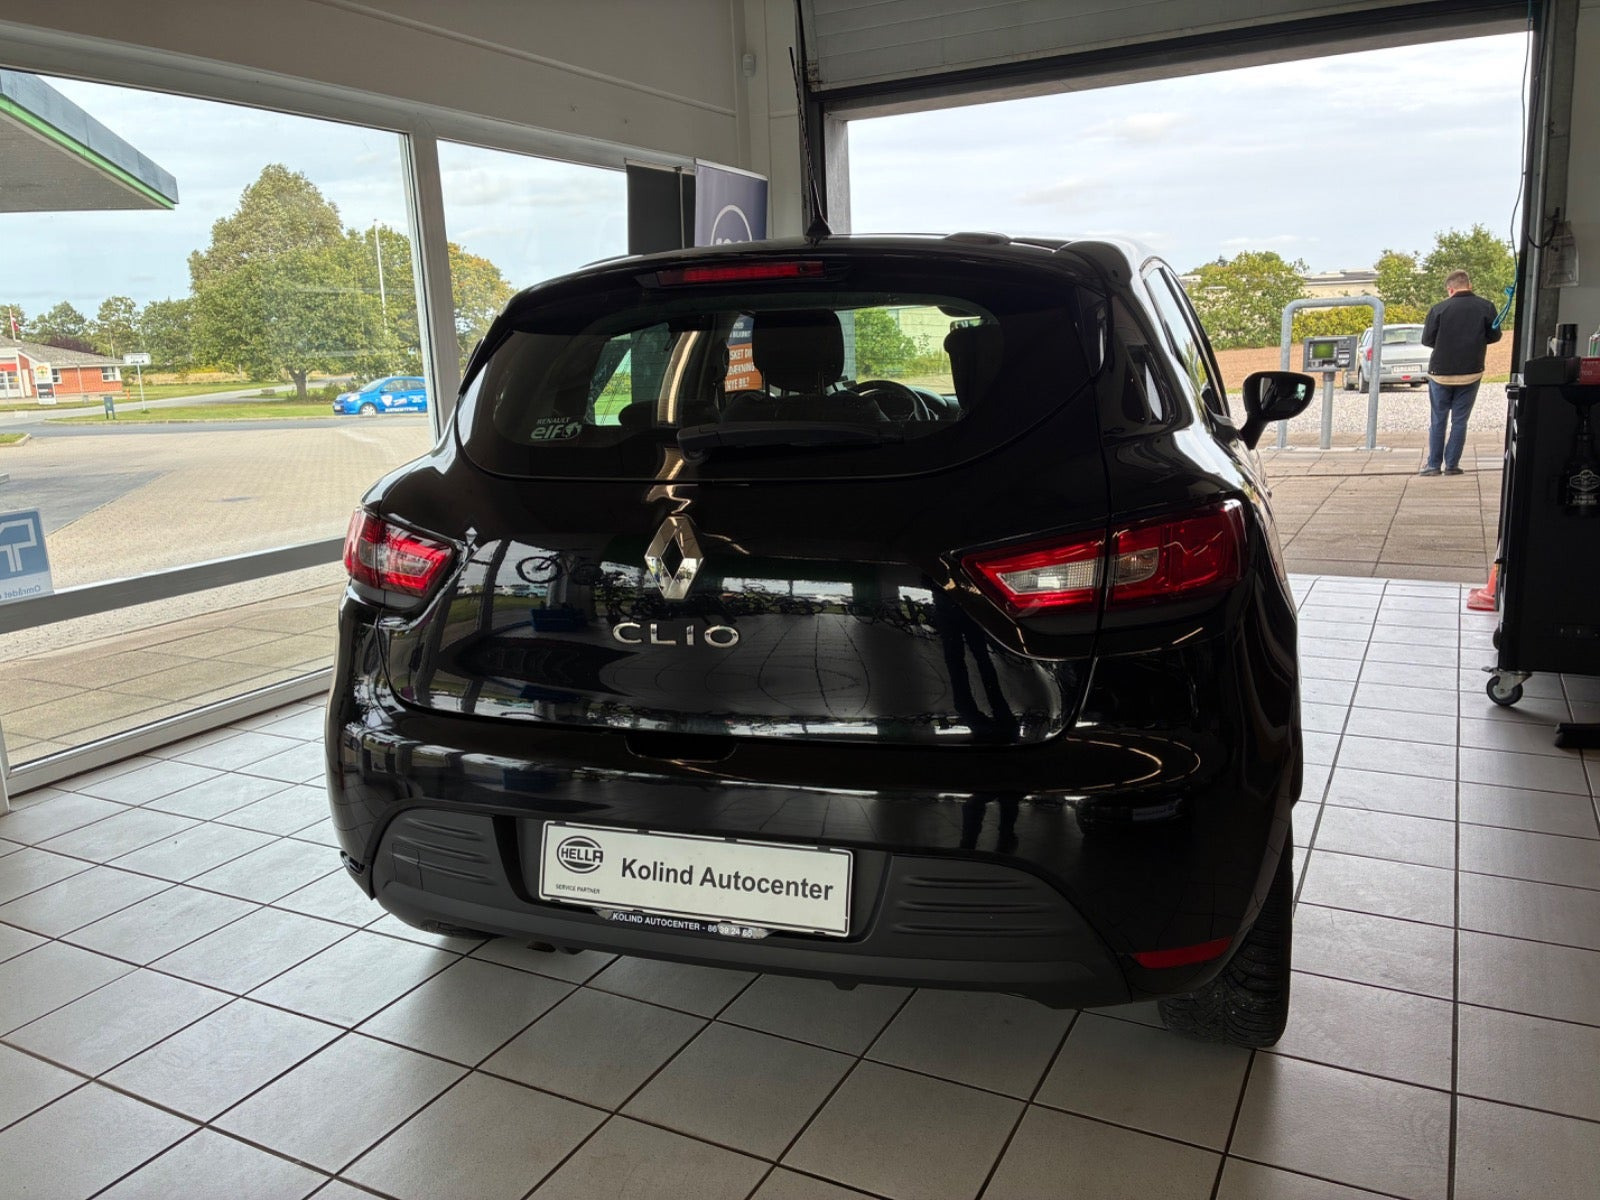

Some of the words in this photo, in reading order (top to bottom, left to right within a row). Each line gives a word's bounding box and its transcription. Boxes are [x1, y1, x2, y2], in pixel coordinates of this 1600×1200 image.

[530, 424, 563, 439] elf
[613, 622, 740, 648] CLIO
[561, 848, 603, 862] HELLA
[621, 857, 694, 886] Kolind
[699, 866, 834, 901] Autocenter
[555, 883, 576, 891] SERVICE
[577, 886, 600, 894] PARTNER
[612, 912, 643, 924] KOLIND
[644, 917, 700, 931] AUTOCENTER
